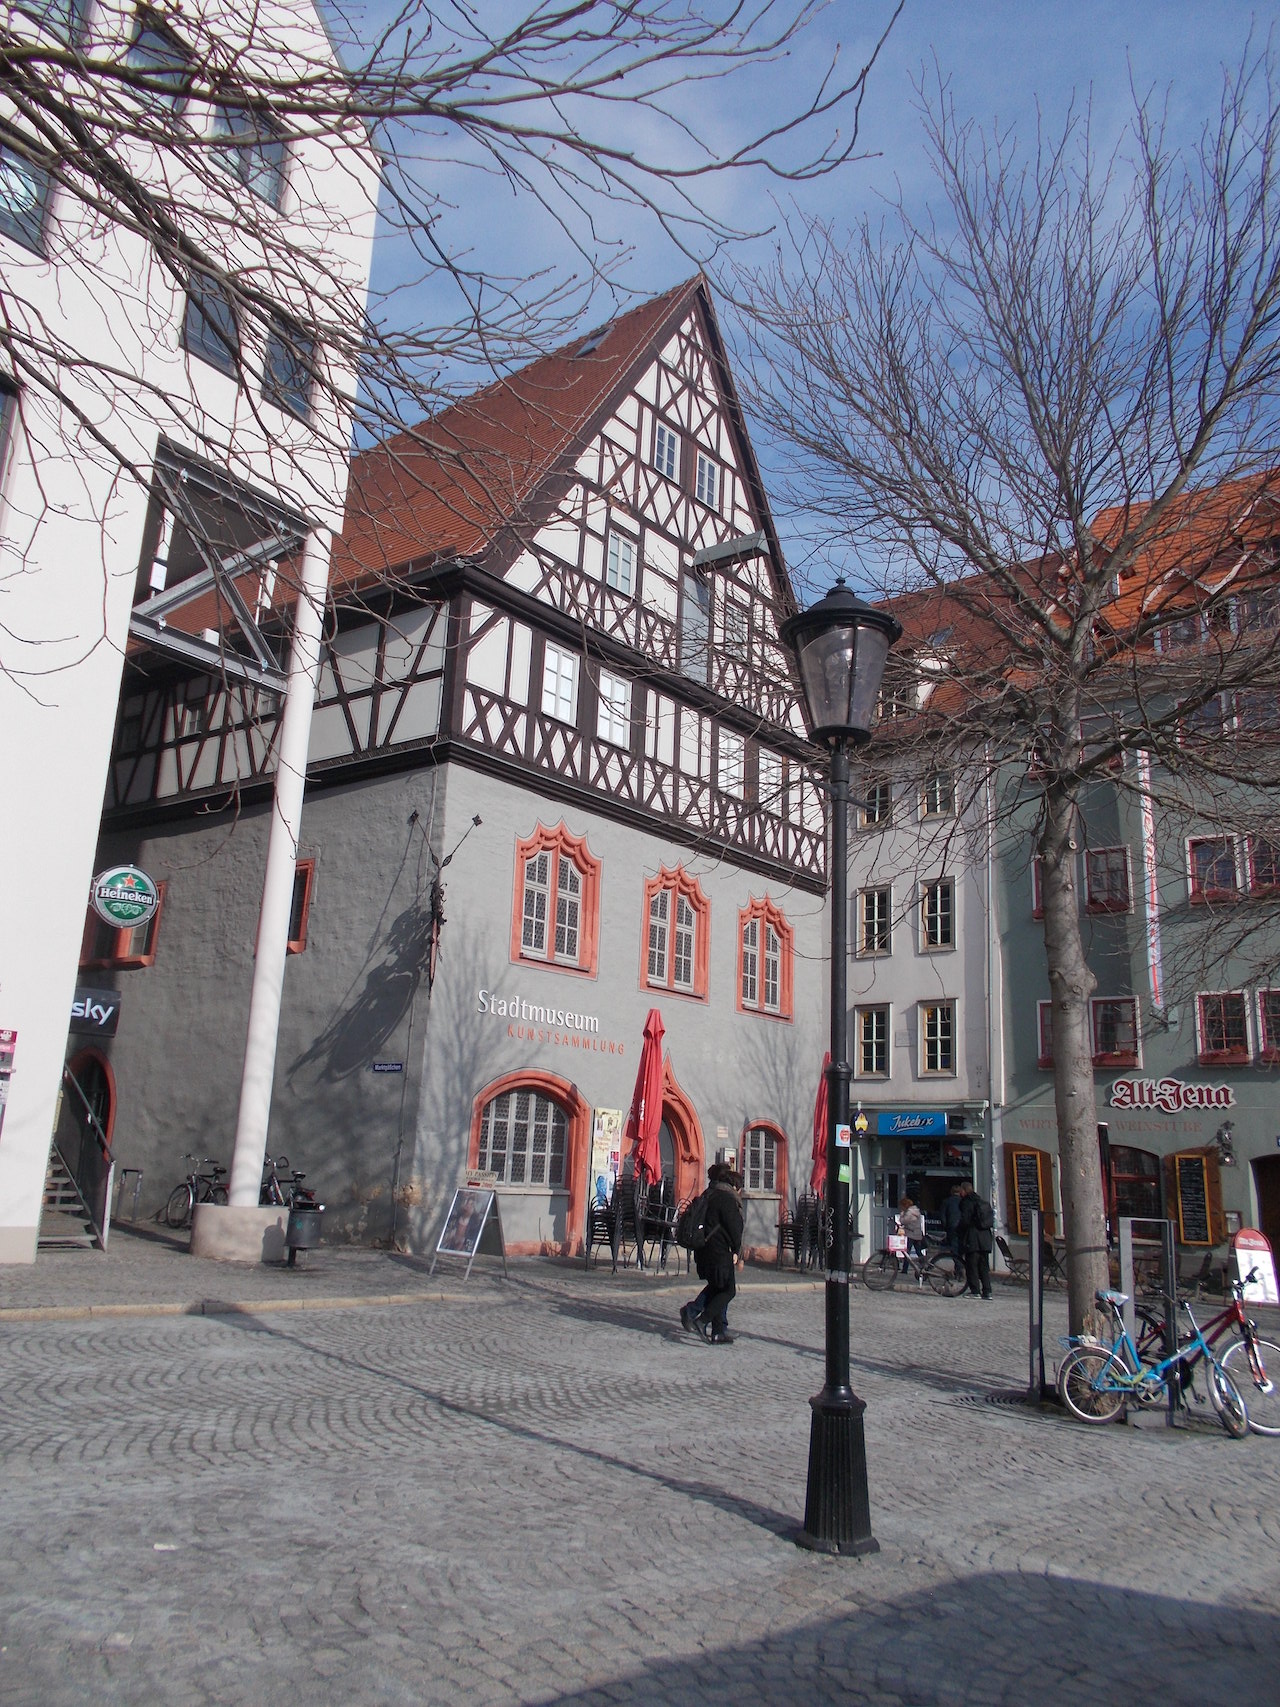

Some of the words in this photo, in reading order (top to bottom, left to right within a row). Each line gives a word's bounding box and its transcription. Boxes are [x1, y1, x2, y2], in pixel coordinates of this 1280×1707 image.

[99, 887, 154, 905] Heineken
[71, 997, 115, 1025] sky
[477, 989, 600, 1033] Stadtmuseum
[507, 1023, 625, 1056] KUNSTSAMMLUNG
[1115, 1120, 1203, 1133] WEINSTUBE
